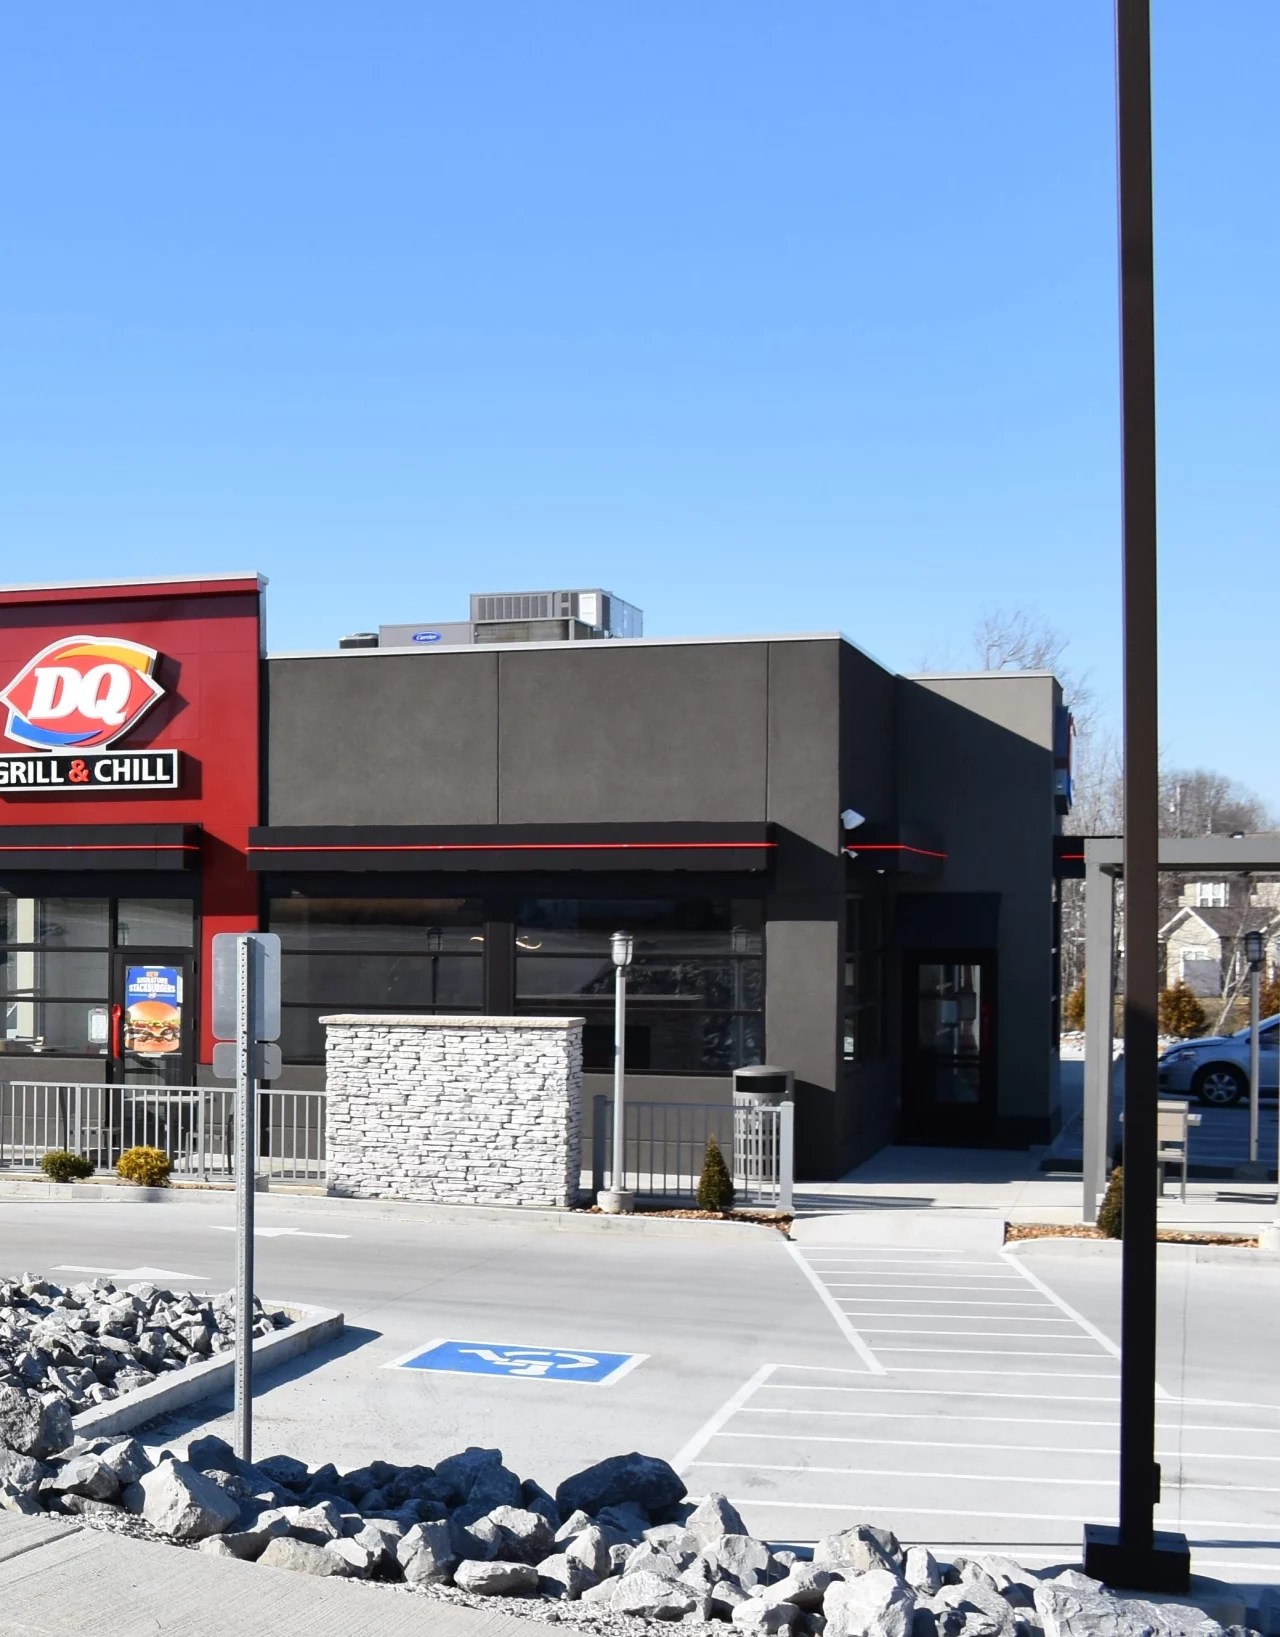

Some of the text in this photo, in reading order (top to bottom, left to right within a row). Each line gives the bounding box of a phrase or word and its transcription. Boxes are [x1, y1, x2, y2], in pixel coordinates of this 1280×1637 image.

[27, 663, 132, 726] DQ
[68, 759, 90, 785] &
[94, 757, 170, 782] CHILL
